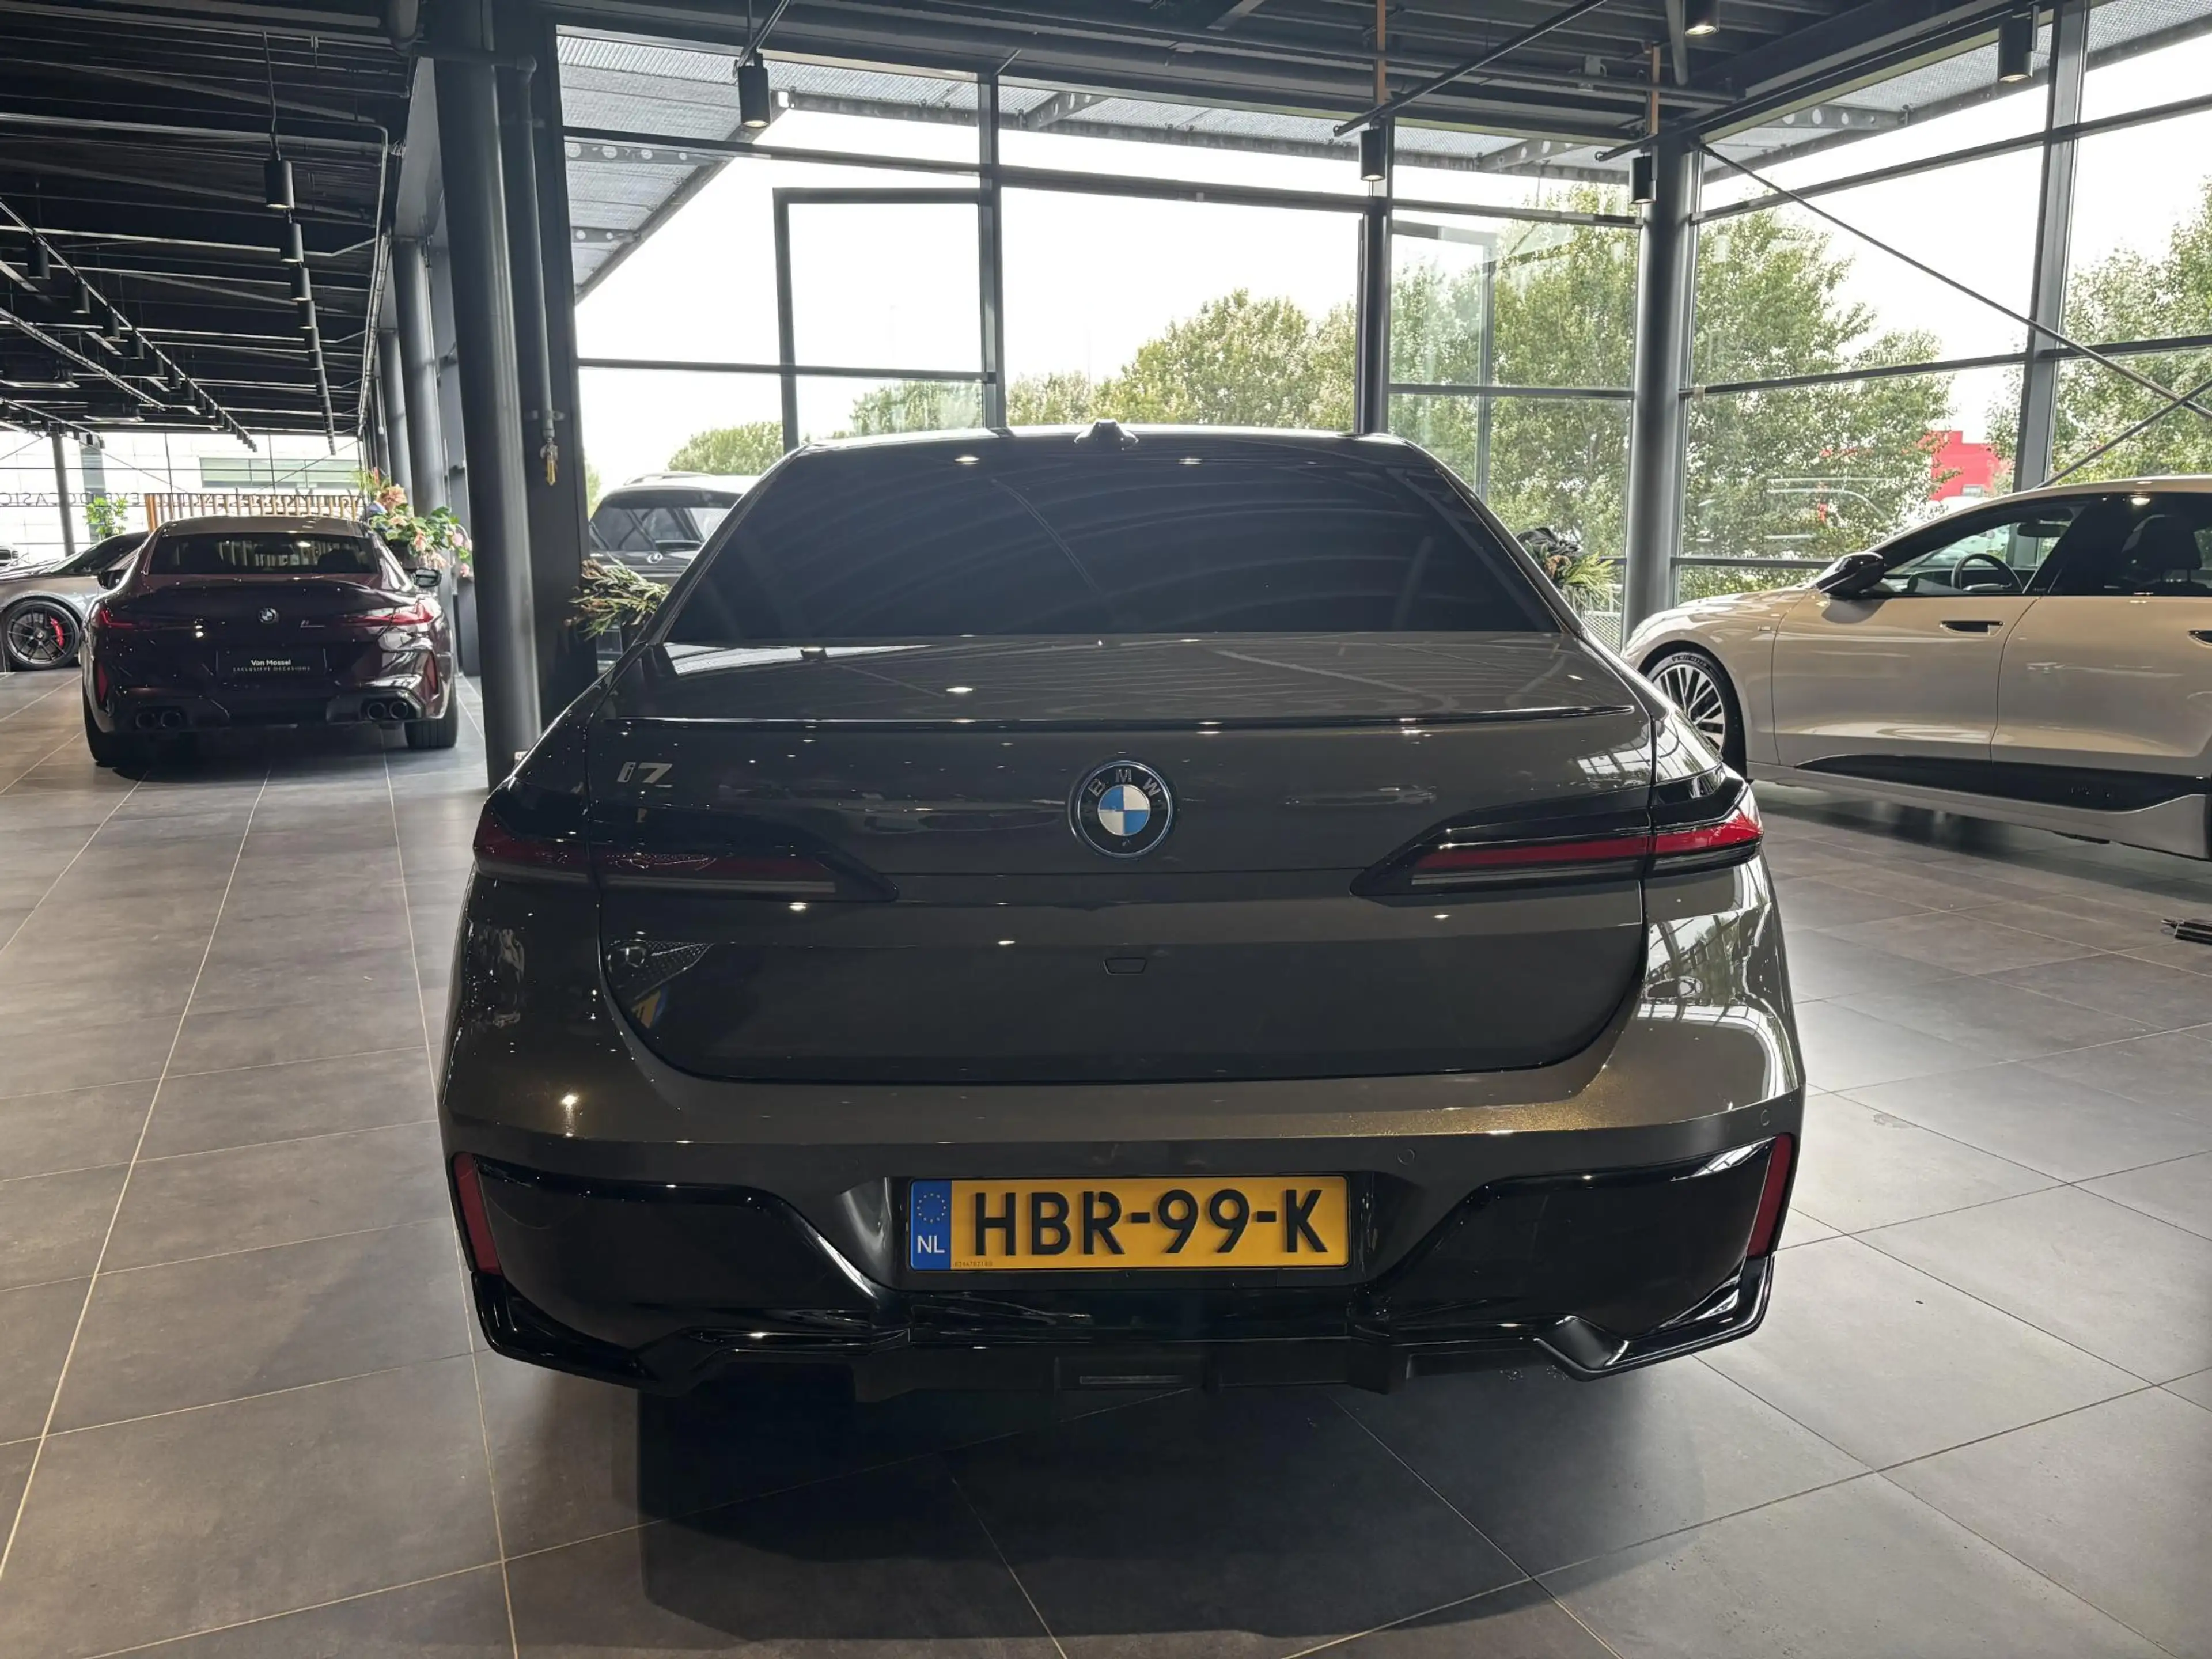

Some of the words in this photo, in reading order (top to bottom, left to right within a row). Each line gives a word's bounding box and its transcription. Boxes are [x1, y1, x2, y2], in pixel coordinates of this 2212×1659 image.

[617, 761, 673, 783] i7
[1088, 769, 1161, 797] BMW
[975, 1188, 1329, 1256] HBR-99-K
[917, 1235, 946, 1254] NL
